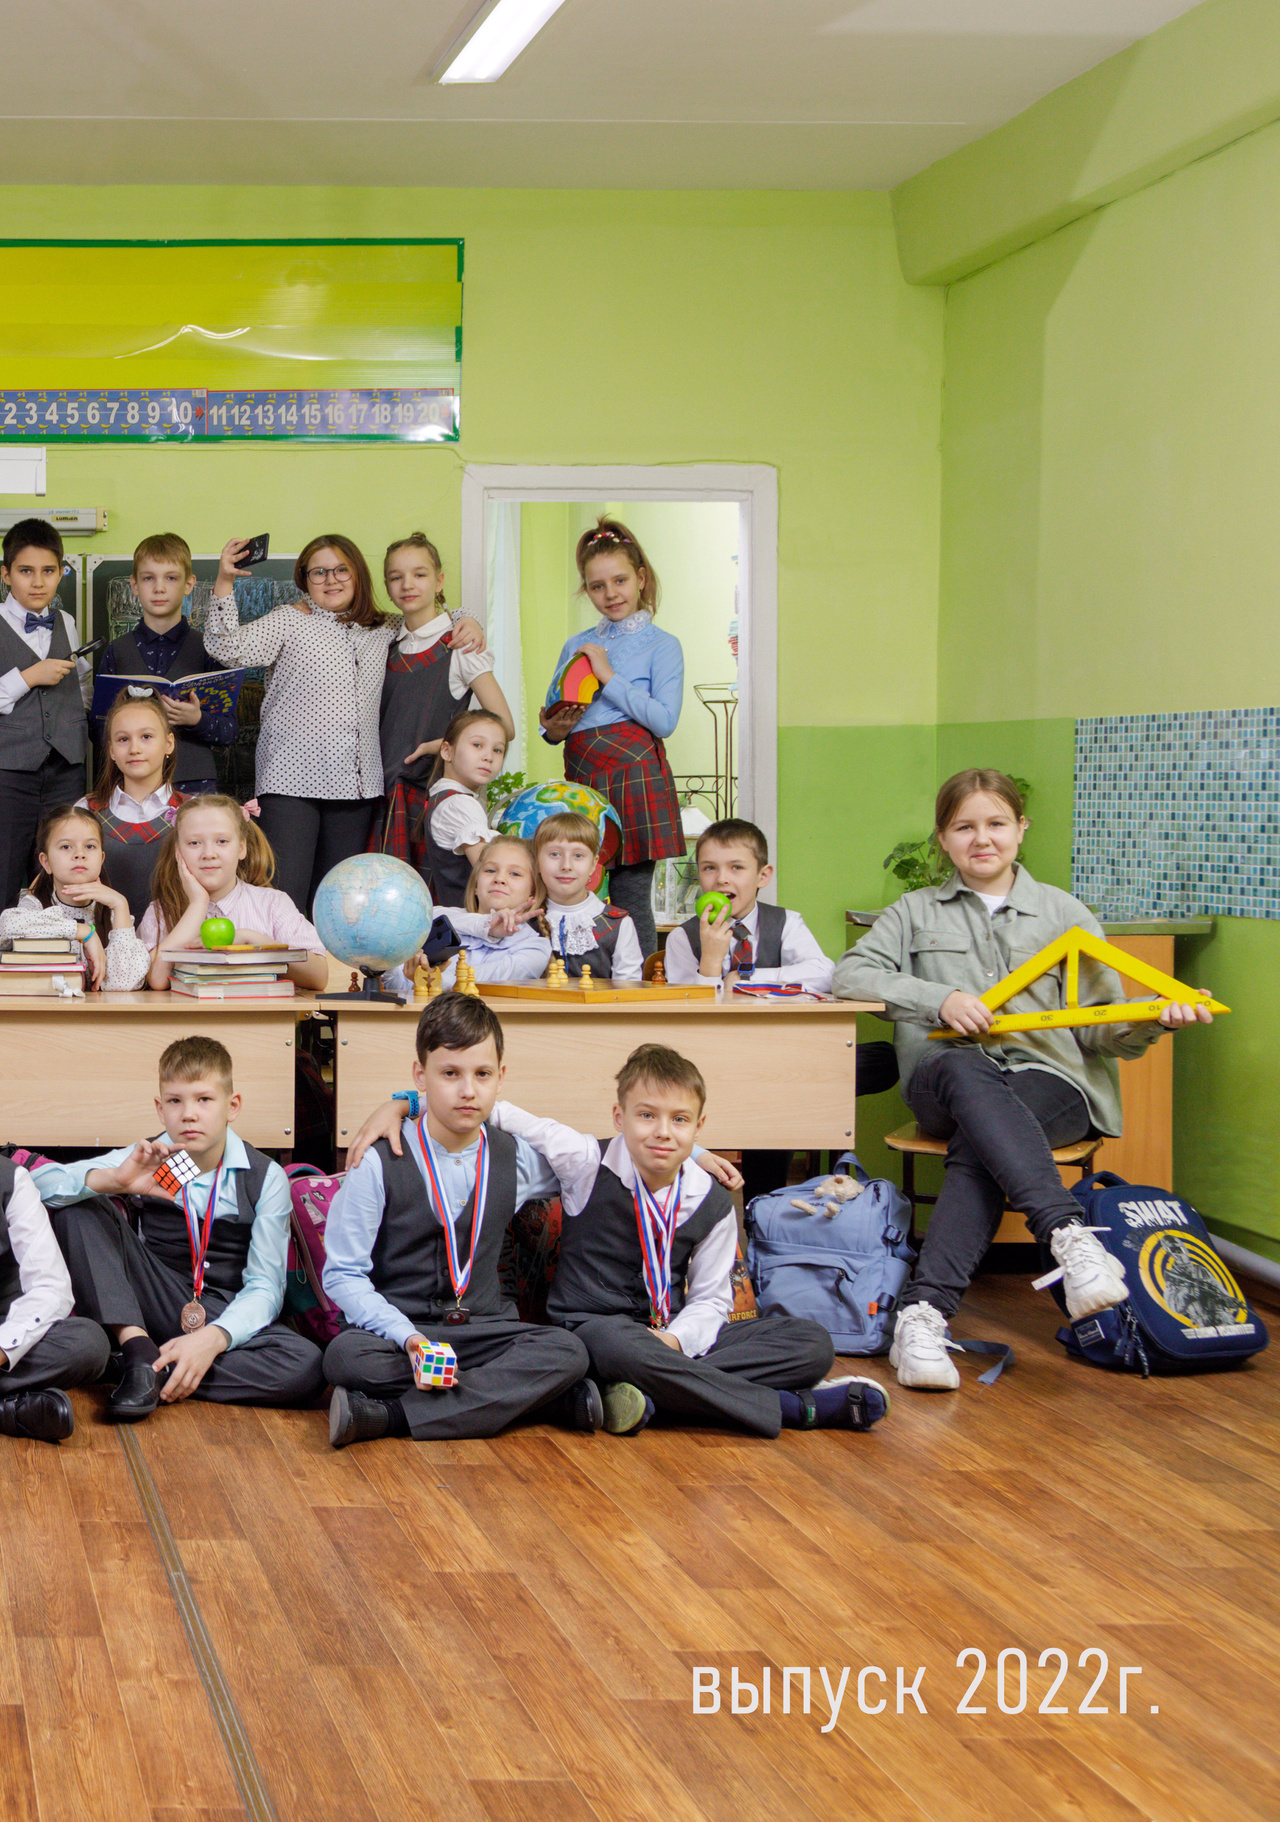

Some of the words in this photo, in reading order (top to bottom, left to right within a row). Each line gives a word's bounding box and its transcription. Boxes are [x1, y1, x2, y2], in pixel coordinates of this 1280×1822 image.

[4, 402, 17, 425] 2
[25, 402, 38, 425] 3
[45, 402, 59, 425] 4
[66, 402, 79, 425] 5
[87, 402, 100, 425] 6
[107, 402, 120, 425] 7
[126, 402, 140, 425] 8
[147, 402, 160, 425] 9
[167, 402, 192, 425] 10
[209, 403, 227, 425] 11
[230, 403, 251, 425] 12
[254, 403, 274, 425] 13
[277, 403, 298, 425] 14
[301, 403, 320, 425] 15
[325, 403, 345, 425] 16
[349, 403, 368, 425] 17
[372, 403, 391, 425] 18
[394, 403, 414, 425] 19
[417, 403, 439, 425] 20
[1118, 1200, 1189, 1228] SWAT
[728, 1309, 757, 1322] IRFORCE
